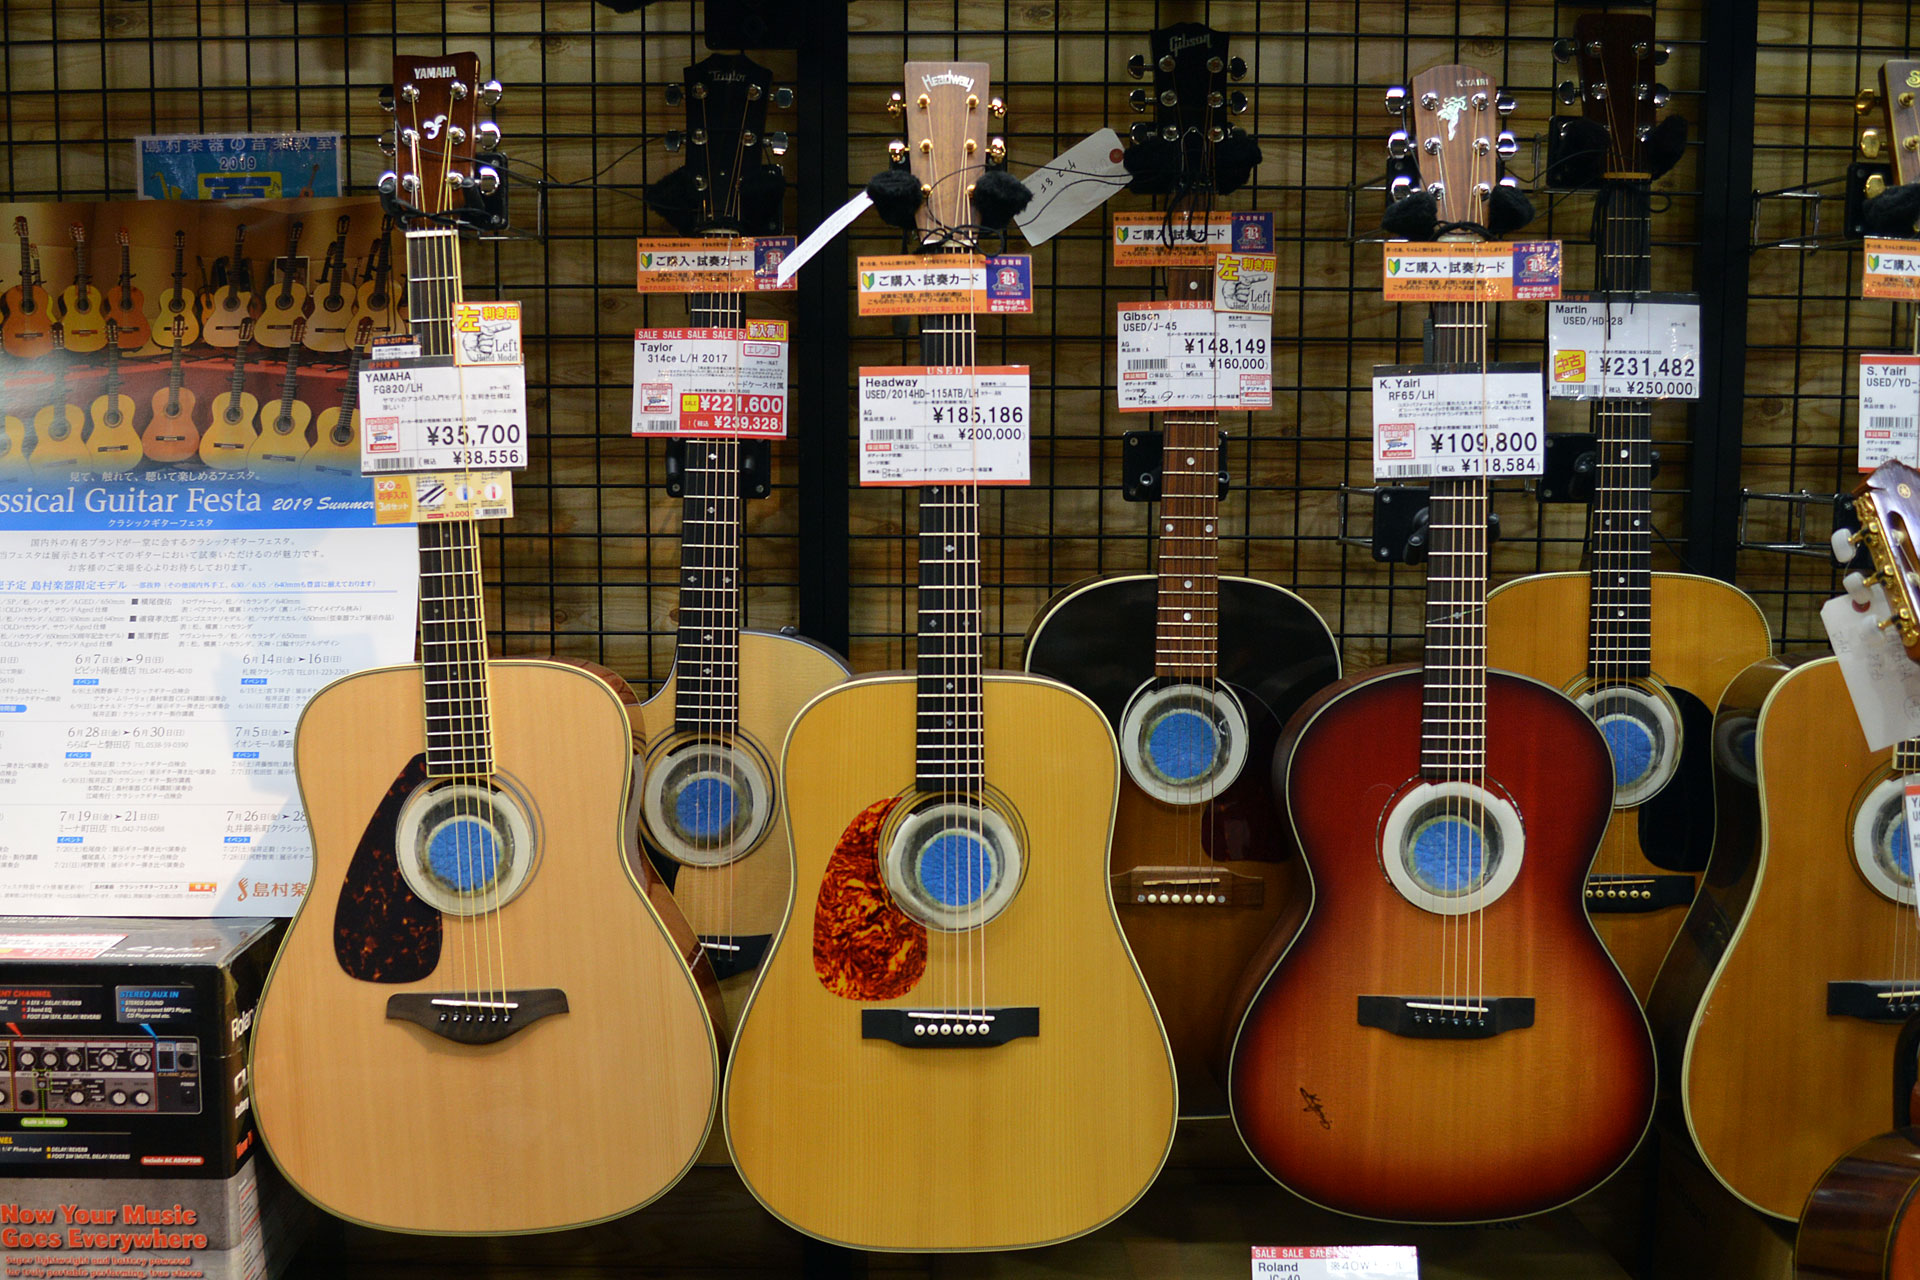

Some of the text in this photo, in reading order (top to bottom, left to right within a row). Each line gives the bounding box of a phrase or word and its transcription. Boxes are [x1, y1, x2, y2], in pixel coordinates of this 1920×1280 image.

[414, 66, 457, 79] YAMAHA
[708, 70, 747, 84] Taylor
[921, 69, 974, 92] Headway
[219, 156, 257, 171] 2019
[656, 255, 748, 268] ご購入・試奏カード
[1403, 261, 1506, 274] ご購入・試奏カード
[878, 273, 980, 288] ご購入・試奏カード
[1250, 290, 1271, 303] Left
[1179, 301, 1213, 310] USED
[1251, 303, 1271, 312] Model
[1555, 304, 1588, 315] Martin
[456, 306, 519, 332] 左利き用
[1123, 312, 1160, 322] Gibson
[1123, 322, 1177, 332] USED/J-45
[638, 330, 733, 339] SALE SALE SALE SALE
[494, 338, 518, 354] Left
[640, 342, 673, 354] Taylor
[746, 346, 778, 355] エレアコ
[1185, 338, 1266, 355] ¥148,149
[499, 352, 519, 362] Model
[647, 353, 728, 364] 314ce L/H 2017
[1556, 354, 1582, 371] 中古
[926, 367, 963, 375] USED
[1599, 357, 1696, 378] ¥231,482
[1866, 366, 1907, 376] S. Yairi
[365, 371, 412, 383] YAMAHA
[373, 383, 423, 396] FG820/LH
[865, 378, 918, 389] Headway
[1379, 378, 1421, 389] K. Yairi
[865, 388, 980, 400] USED/2014HD-115ATB/LH
[1388, 390, 1435, 401] RF65/LH
[699, 395, 783, 413] ¥221,600
[933, 406, 1023, 425] ¥185,186
[426, 423, 521, 447] ¥35,700
[1430, 432, 1537, 454] ¥109,800
[70, 471, 261, 483] 見て、触れて、聴いて楽しめるフェスタ。
[0, 486, 374, 513] ssical Guitar Festa 2019 Summer
[108, 519, 214, 528] クラシックギターフェスタ
[31, 537, 294, 549] 国内外の有名ブランドが一堂に会するクラシックギターフェスタ。
[68, 562, 253, 573] お客様のご来場を心よりお待ちしております。
[31, 580, 127, 591] 島村楽器限定モデル
[75, 653, 123, 665] 6月7日(金)
[242, 653, 296, 665] 6月14日(金)
[68, 726, 121, 738] 6月28日(金)
[235, 726, 282, 738] 7月5日(金)
[59, 810, 113, 822] 7月19日(金)
[226, 810, 281, 822] 7月26日(金)
[13, 990, 180, 999] CHANNEL STEREO AUX IN
[0, 1203, 198, 1224] Now Your Music
[0, 1228, 208, 1254] Goes Everywhere
[1255, 1248, 1277, 1258] SALE
[1282, 1248, 1304, 1258] SALE
[5, 1255, 191, 1267] Super lightweight and battery powered
[1258, 1262, 1298, 1272] Roland
[5, 1268, 204, 1280] for truly portable performing, true stereo
